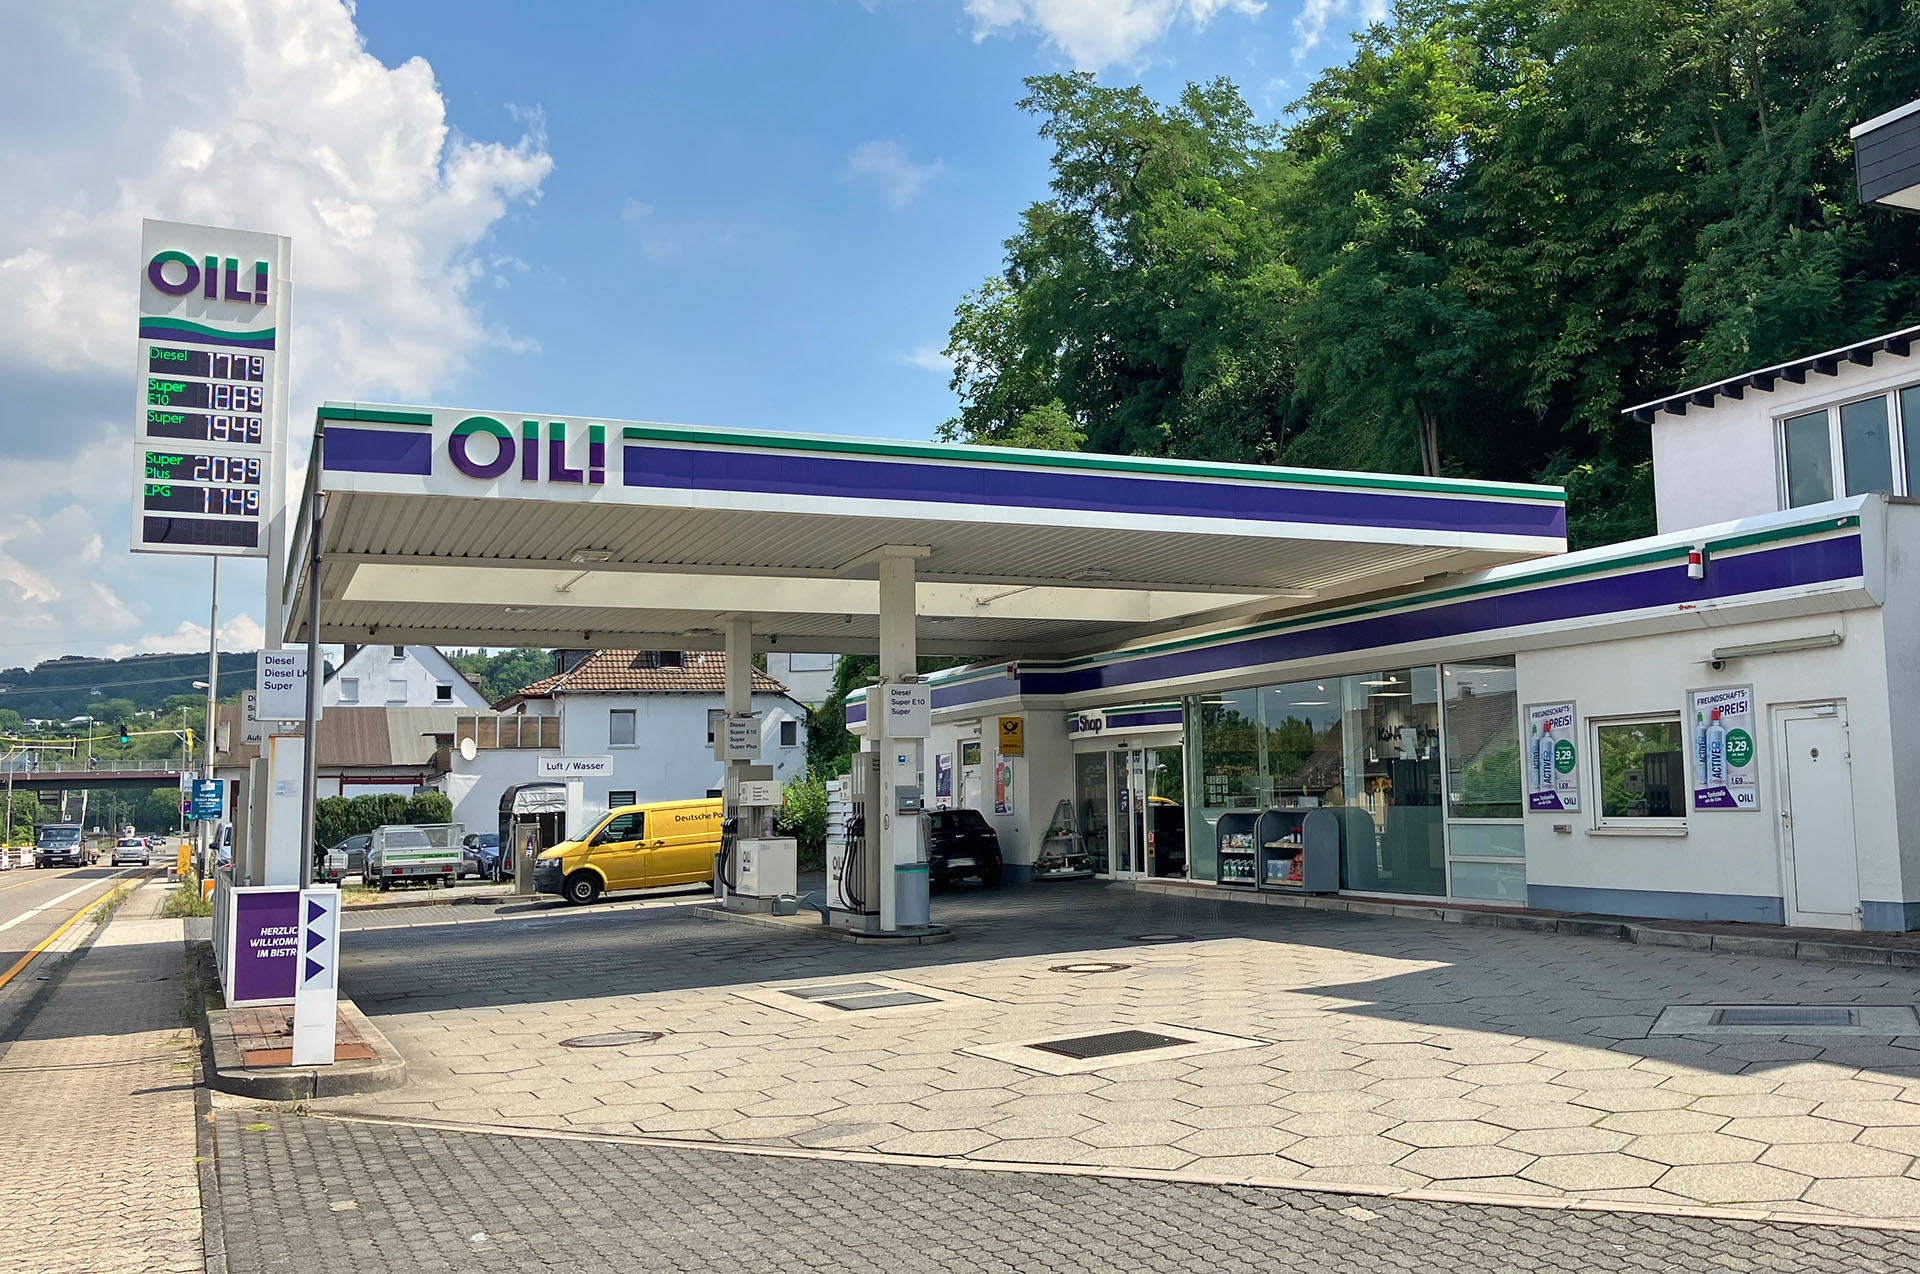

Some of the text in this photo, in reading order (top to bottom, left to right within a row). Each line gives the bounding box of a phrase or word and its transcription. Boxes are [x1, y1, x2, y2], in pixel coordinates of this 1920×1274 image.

[148, 250, 269, 305] OIL!
[150, 346, 188, 361] Diesel
[148, 378, 186, 394] Super
[148, 393, 170, 406] E10
[147, 410, 185, 426] Super
[448, 416, 605, 485] OIL!
[145, 451, 184, 467] Super
[145, 467, 171, 479] Plus
[144, 484, 171, 497] LPG
[265, 656, 295, 665] Diesel
[264, 669, 294, 677] Diesel
[264, 681, 293, 691] Super
[1697, 690, 1748, 706] FREUNDSCHAFTS-
[1532, 704, 1572, 719] FREUNDSCHAFTS-
[1719, 700, 1748, 716] PREIS!
[1080, 715, 1102, 734] Shop
[1549, 714, 1572, 728] PREIS!
[546, 762, 563, 771] Luft
[573, 762, 604, 770] Wasser
[675, 813, 711, 822] Deutsche
[257, 948, 298, 958] IM BISTR
